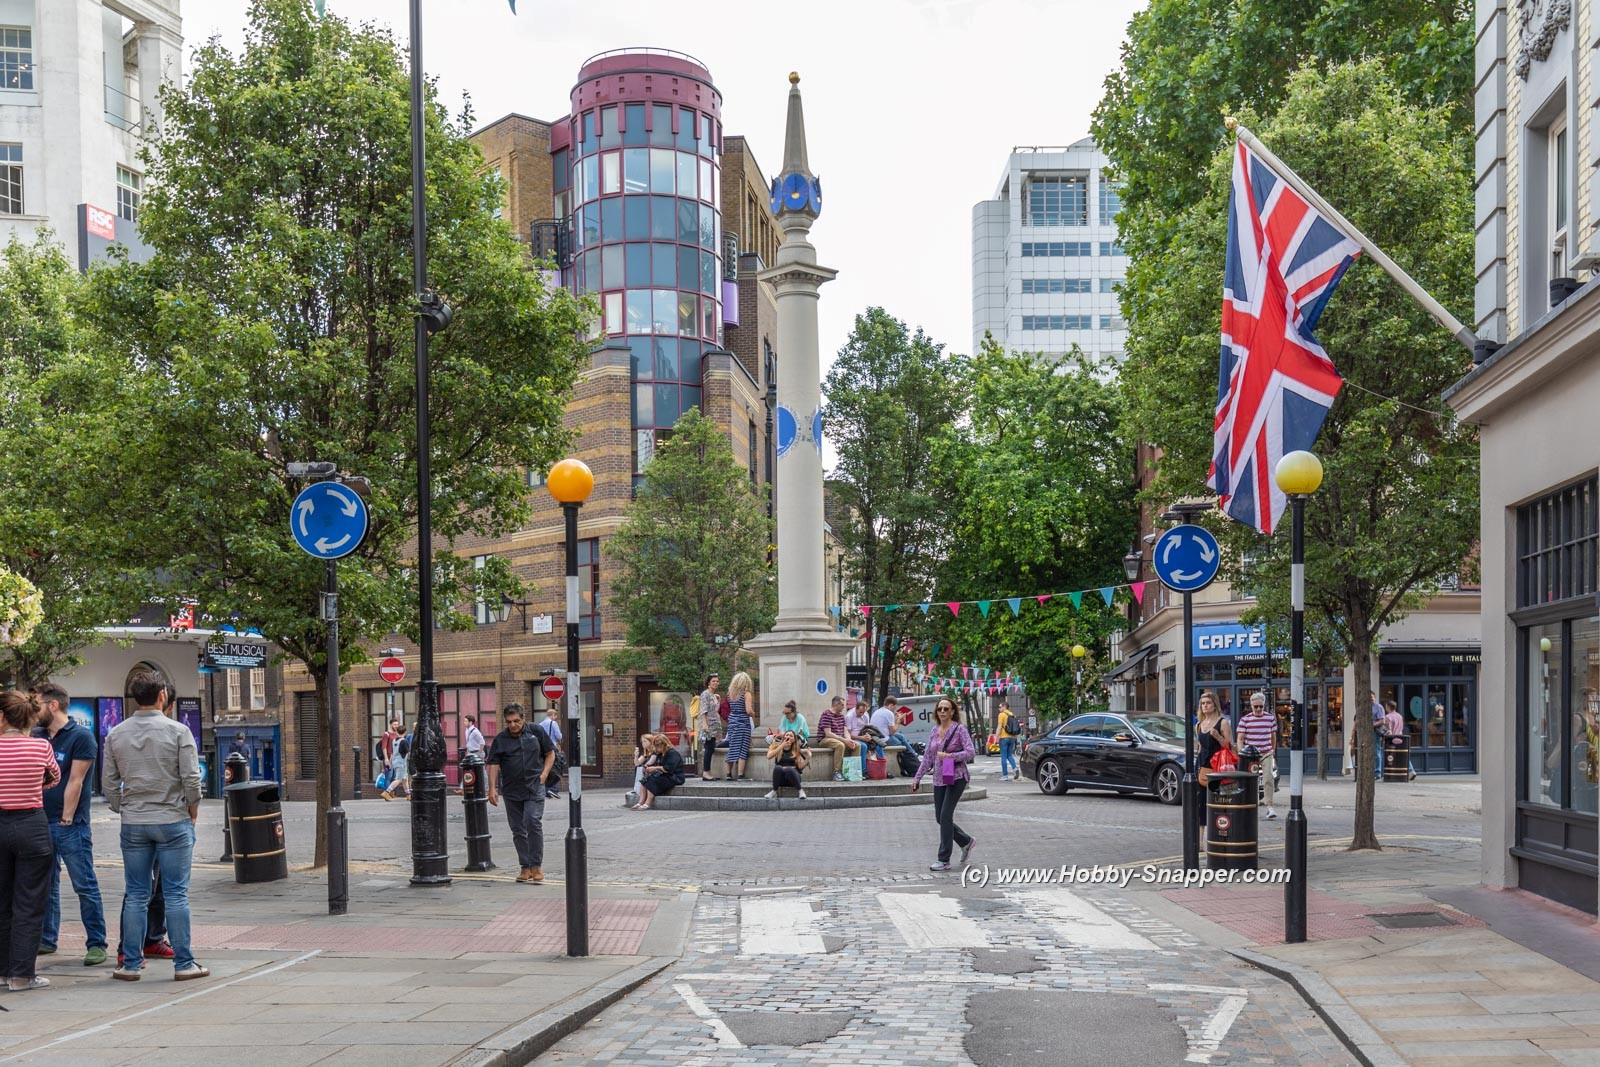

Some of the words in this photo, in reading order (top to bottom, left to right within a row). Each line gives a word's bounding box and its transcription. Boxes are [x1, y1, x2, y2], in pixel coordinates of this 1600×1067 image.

[89, 207, 112, 229] RSC
[207, 643, 229, 655] BEST
[231, 644, 266, 657] MUSICAL
[919, 708, 933, 723] dp
